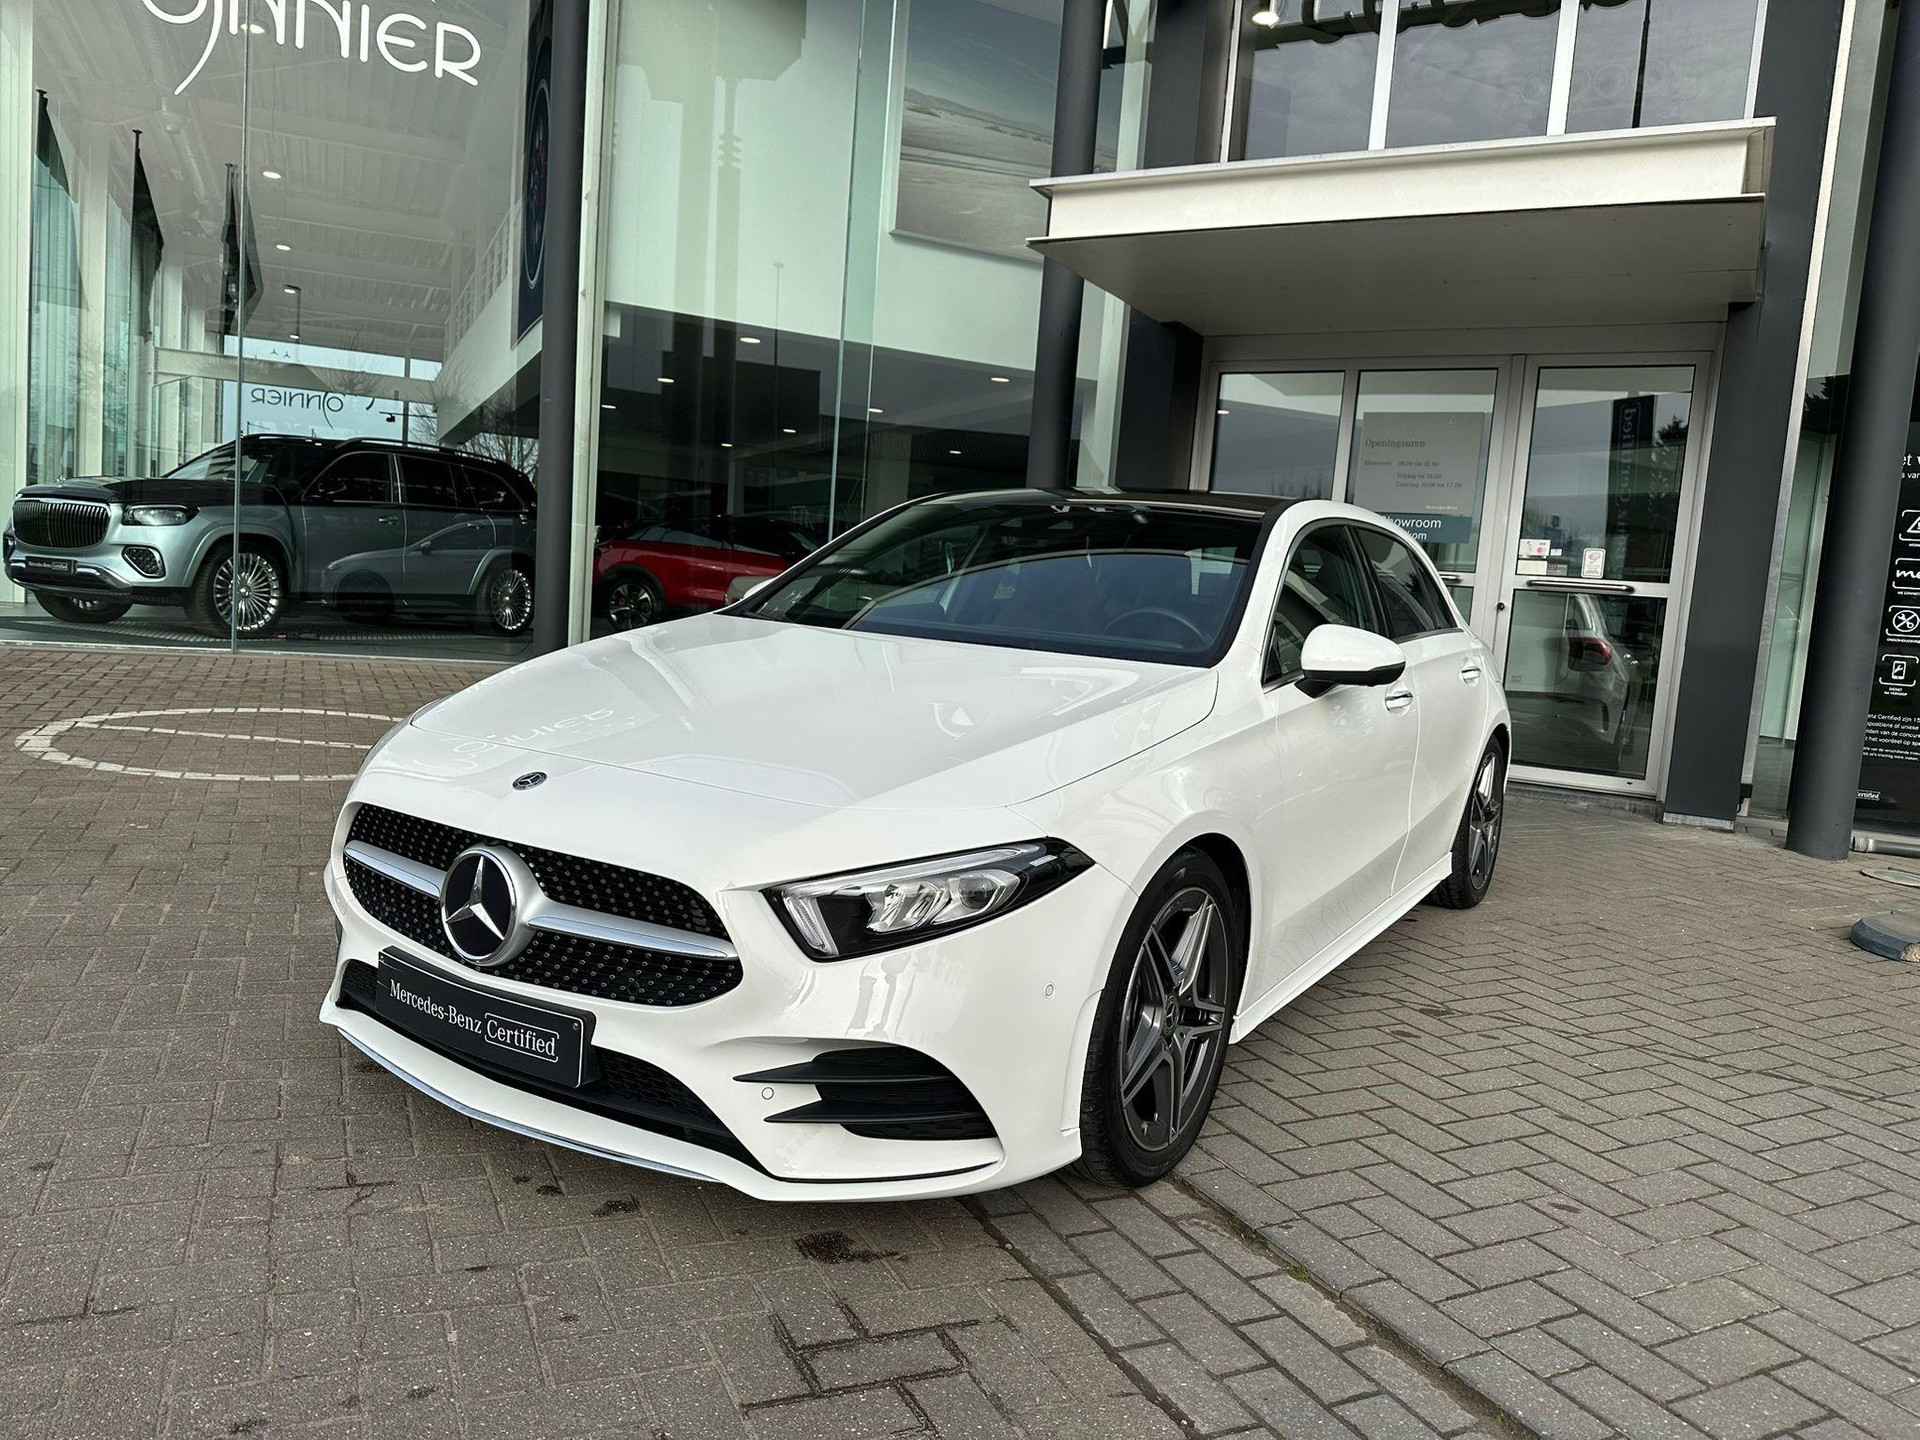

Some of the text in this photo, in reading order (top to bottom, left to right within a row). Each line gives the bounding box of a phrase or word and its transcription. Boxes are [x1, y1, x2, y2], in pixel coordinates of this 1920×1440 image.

[143, 0, 481, 95] NNIER
[389, 979, 556, 1057] Mercedes-Benz Certified
